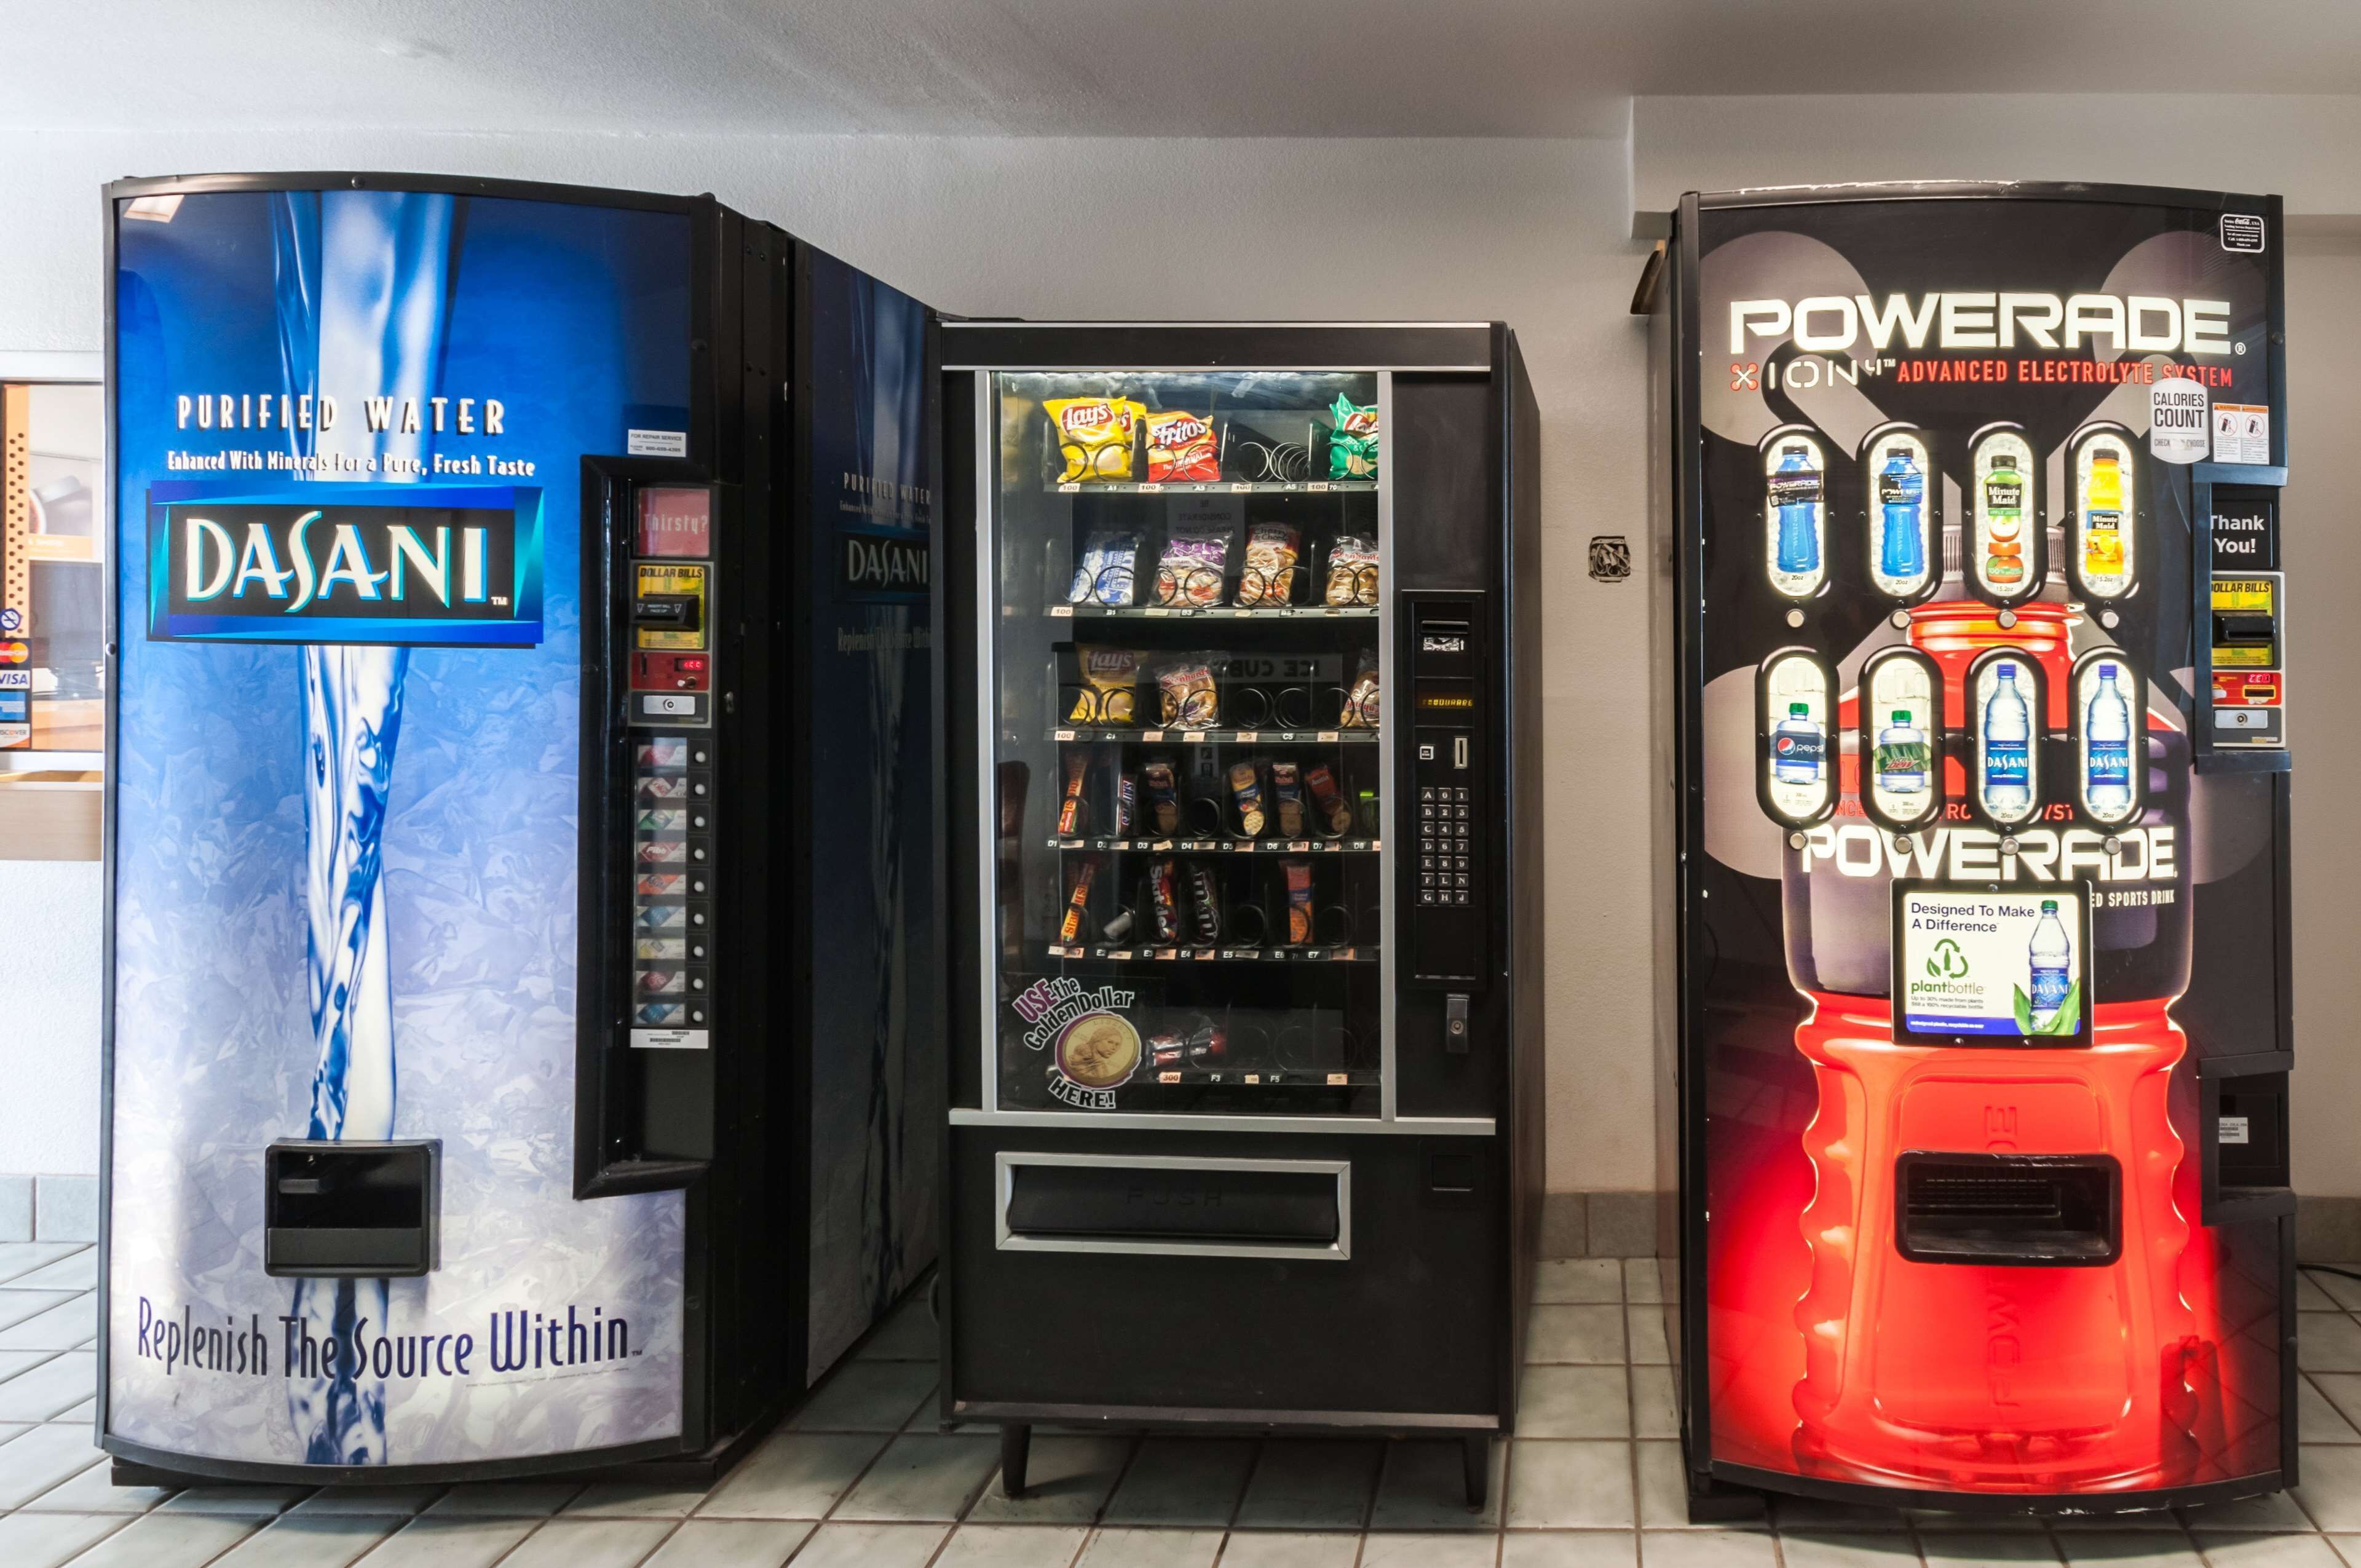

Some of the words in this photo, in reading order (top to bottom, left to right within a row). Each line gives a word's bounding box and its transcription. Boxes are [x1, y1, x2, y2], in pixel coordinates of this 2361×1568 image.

[1730, 291, 2231, 355] POWERADE
[1897, 360, 2008, 382] ADVANCED
[2019, 360, 2153, 385] ELECTROLYTE
[2154, 392, 2204, 407] CALORIES
[177, 394, 338, 432] PURIFIED
[366, 396, 505, 435] WATER
[2154, 408, 2204, 428] COUNT
[167, 450, 226, 470] Enhanced
[229, 451, 263, 470] With
[267, 451, 328, 472] Minerals
[334, 454, 362, 472] For
[366, 458, 376, 472] a
[381, 454, 428, 476] Pure,
[433, 454, 481, 475] Fresh
[486, 454, 536, 478] Taste
[1988, 486, 2020, 496] Minute
[1992, 495, 2018, 505] Maid
[644, 513, 708, 535] Thirsty?
[2211, 515, 2265, 531] Thank
[2213, 538, 2256, 553] You!
[186, 510, 488, 613] DASANI
[847, 539, 927, 588] DASANI
[639, 568, 675, 578] DOLLAR
[678, 568, 703, 579] BILLS
[2245, 583, 2270, 593] BILLS
[1796, 742, 1825, 753] pepsi
[1987, 754, 2028, 770] DASANI
[2089, 754, 2129, 770] DASANI
[1802, 825, 2175, 881] POWERADE
[2108, 890, 2149, 907] SPORTS
[2151, 889, 2175, 905] DRINK
[1911, 902, 1974, 916] Designed
[1979, 905, 1994, 916] To
[1998, 906, 2035, 917] Make
[1912, 919, 1921, 929] A
[1926, 919, 1998, 932] Difference
[1911, 980, 1984, 994] plantbottle
[2031, 983, 2069, 995] DASANI
[1013, 979, 1059, 1023] USE
[1051, 978, 1080, 1000] the
[1024, 1002, 1078, 1050] Golden
[1078, 987, 1134, 1015] Dollar
[1049, 1077, 1116, 1109] HERE!
[138, 1297, 268, 1376] Replenish
[279, 1315, 337, 1380] The
[352, 1316, 473, 1380] Source
[489, 1305, 629, 1373] Within
